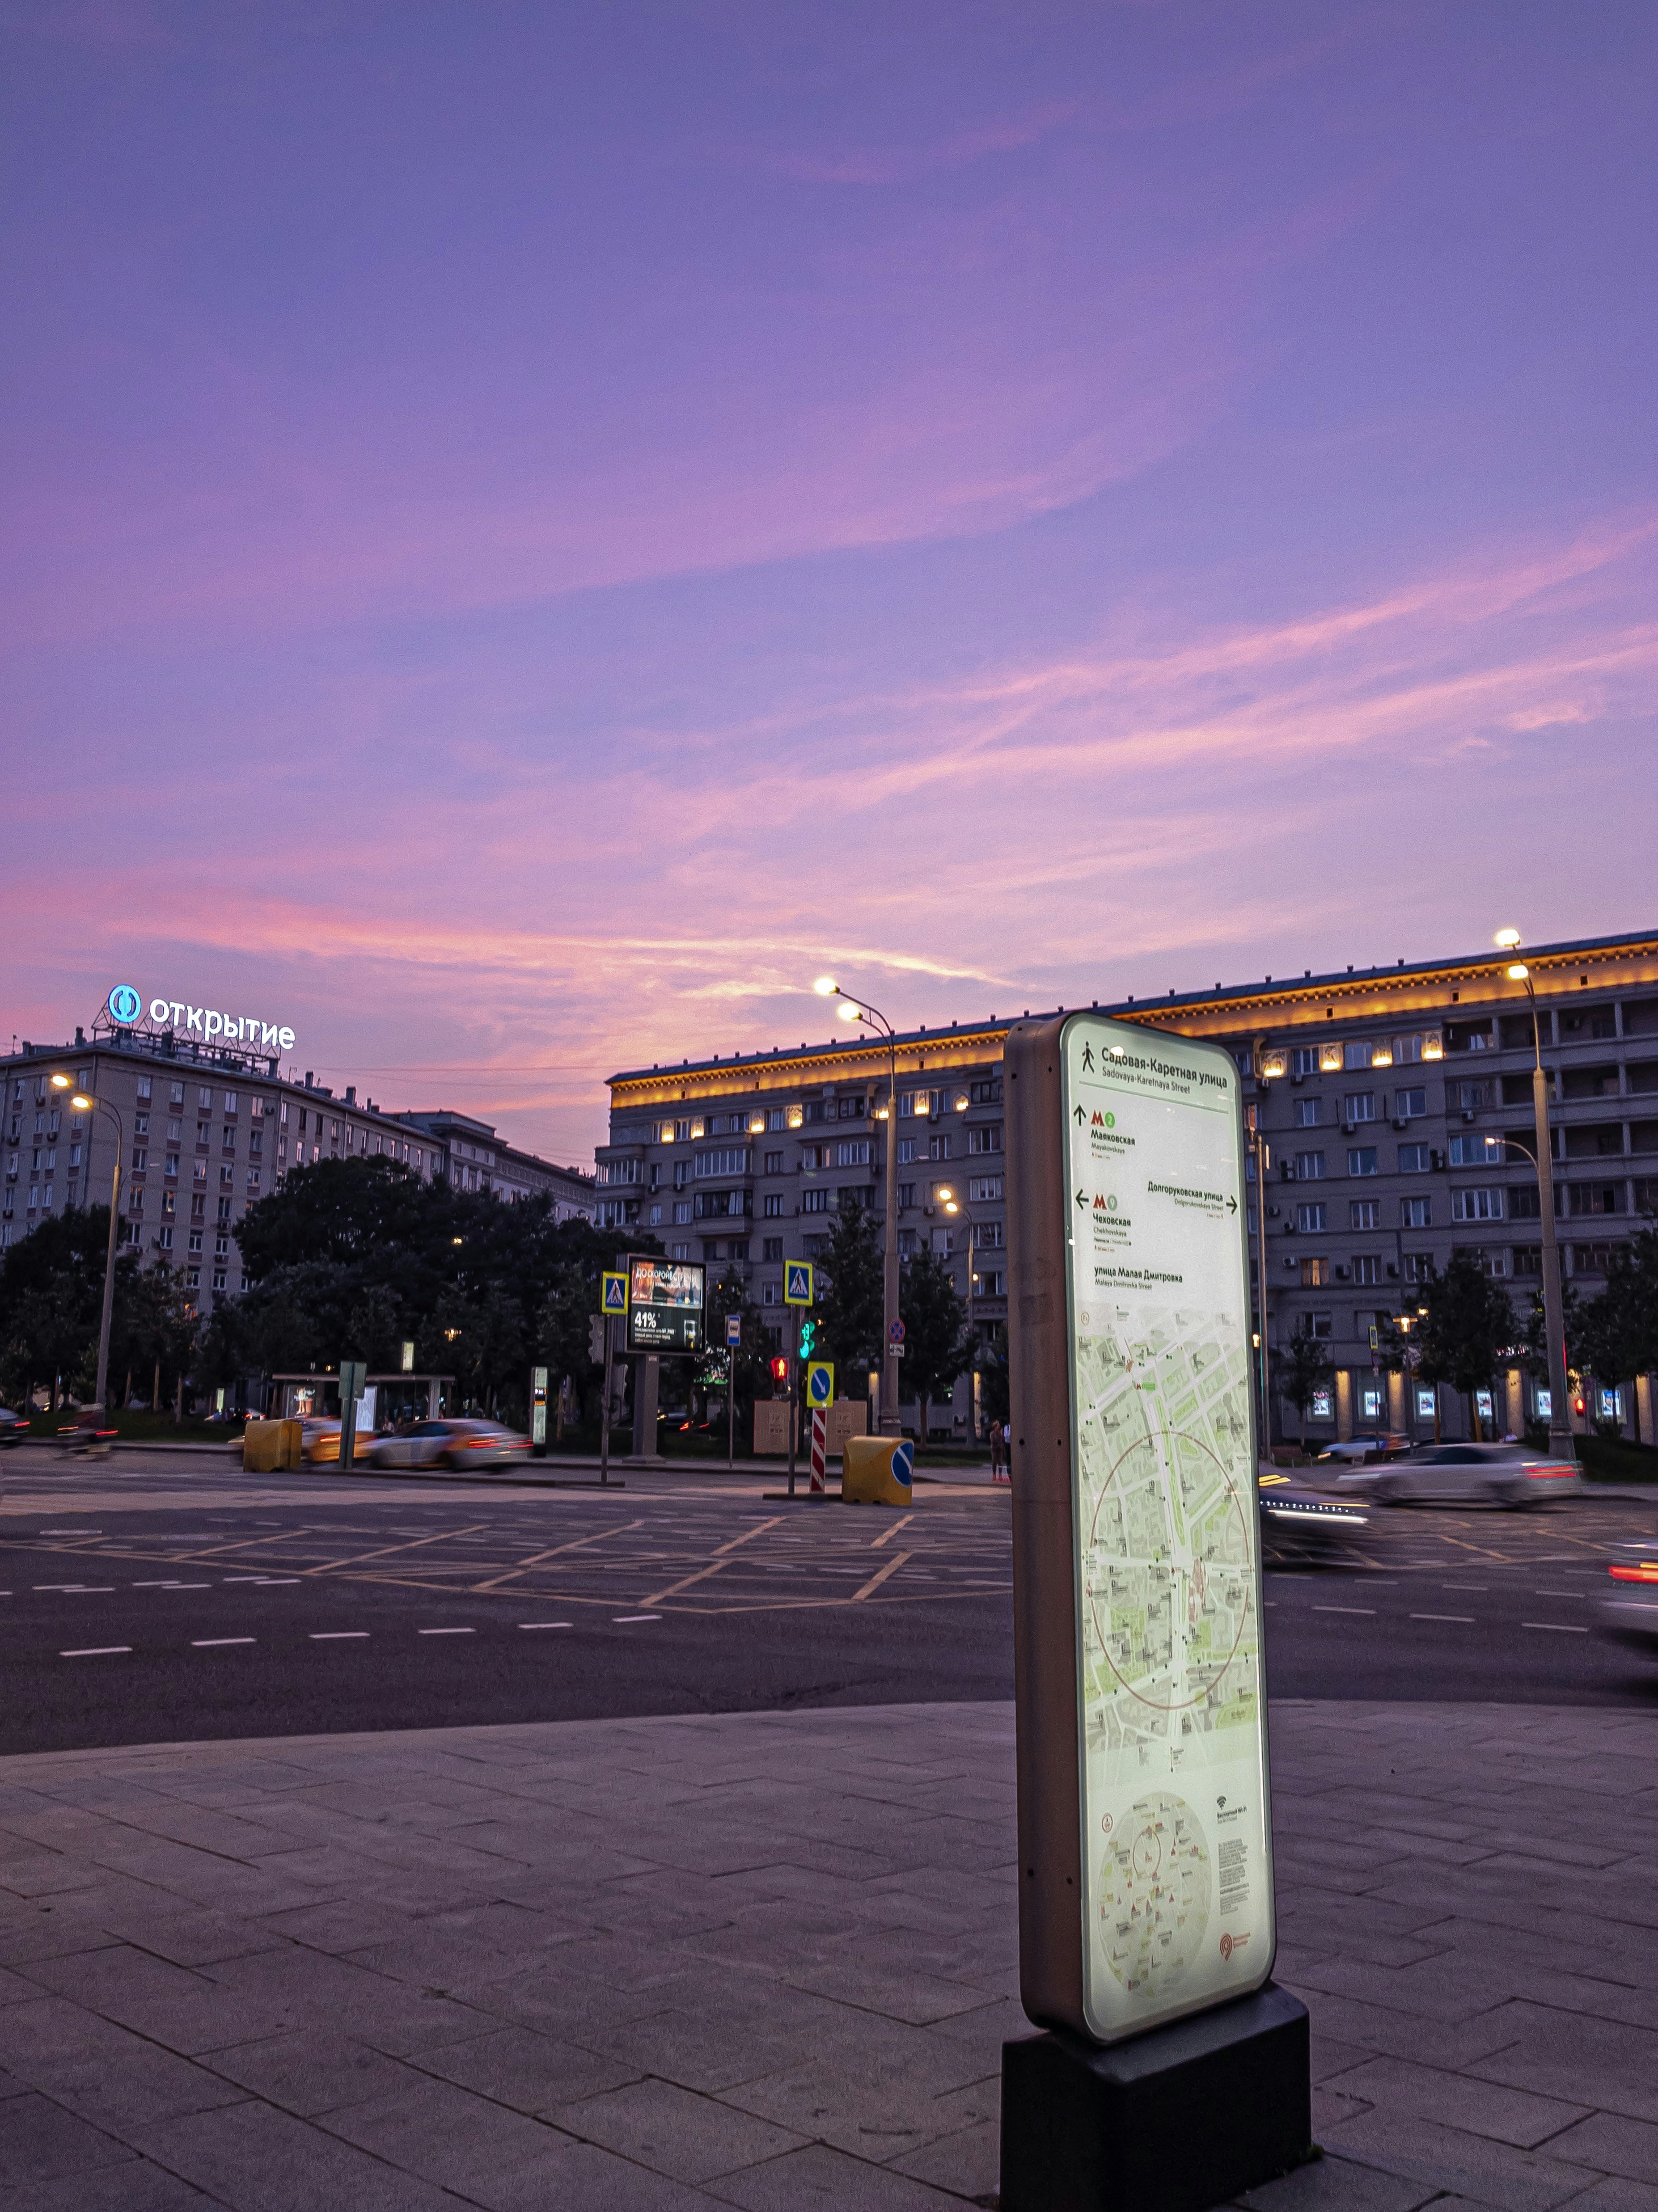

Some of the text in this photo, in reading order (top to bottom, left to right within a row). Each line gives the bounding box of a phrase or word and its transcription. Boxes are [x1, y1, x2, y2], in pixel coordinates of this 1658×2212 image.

[1101, 1047, 1228, 1088] Садовая-Каретная улица
[1102, 1066, 1190, 1095] Sadovaya-Karetnaya Street
[1091, 1128, 1135, 1146] Маяковская
[1091, 1142, 1125, 1155] Mayakovskaya
[1148, 1181, 1223, 1202] Долгоруковская улица
[1093, 1212, 1131, 1227] Чеховская
[1094, 1266, 1183, 1284] улица Малая Дмитровка
[1095, 1278, 1113, 1288] Malaya
[635, 1311, 657, 1328] 41%
